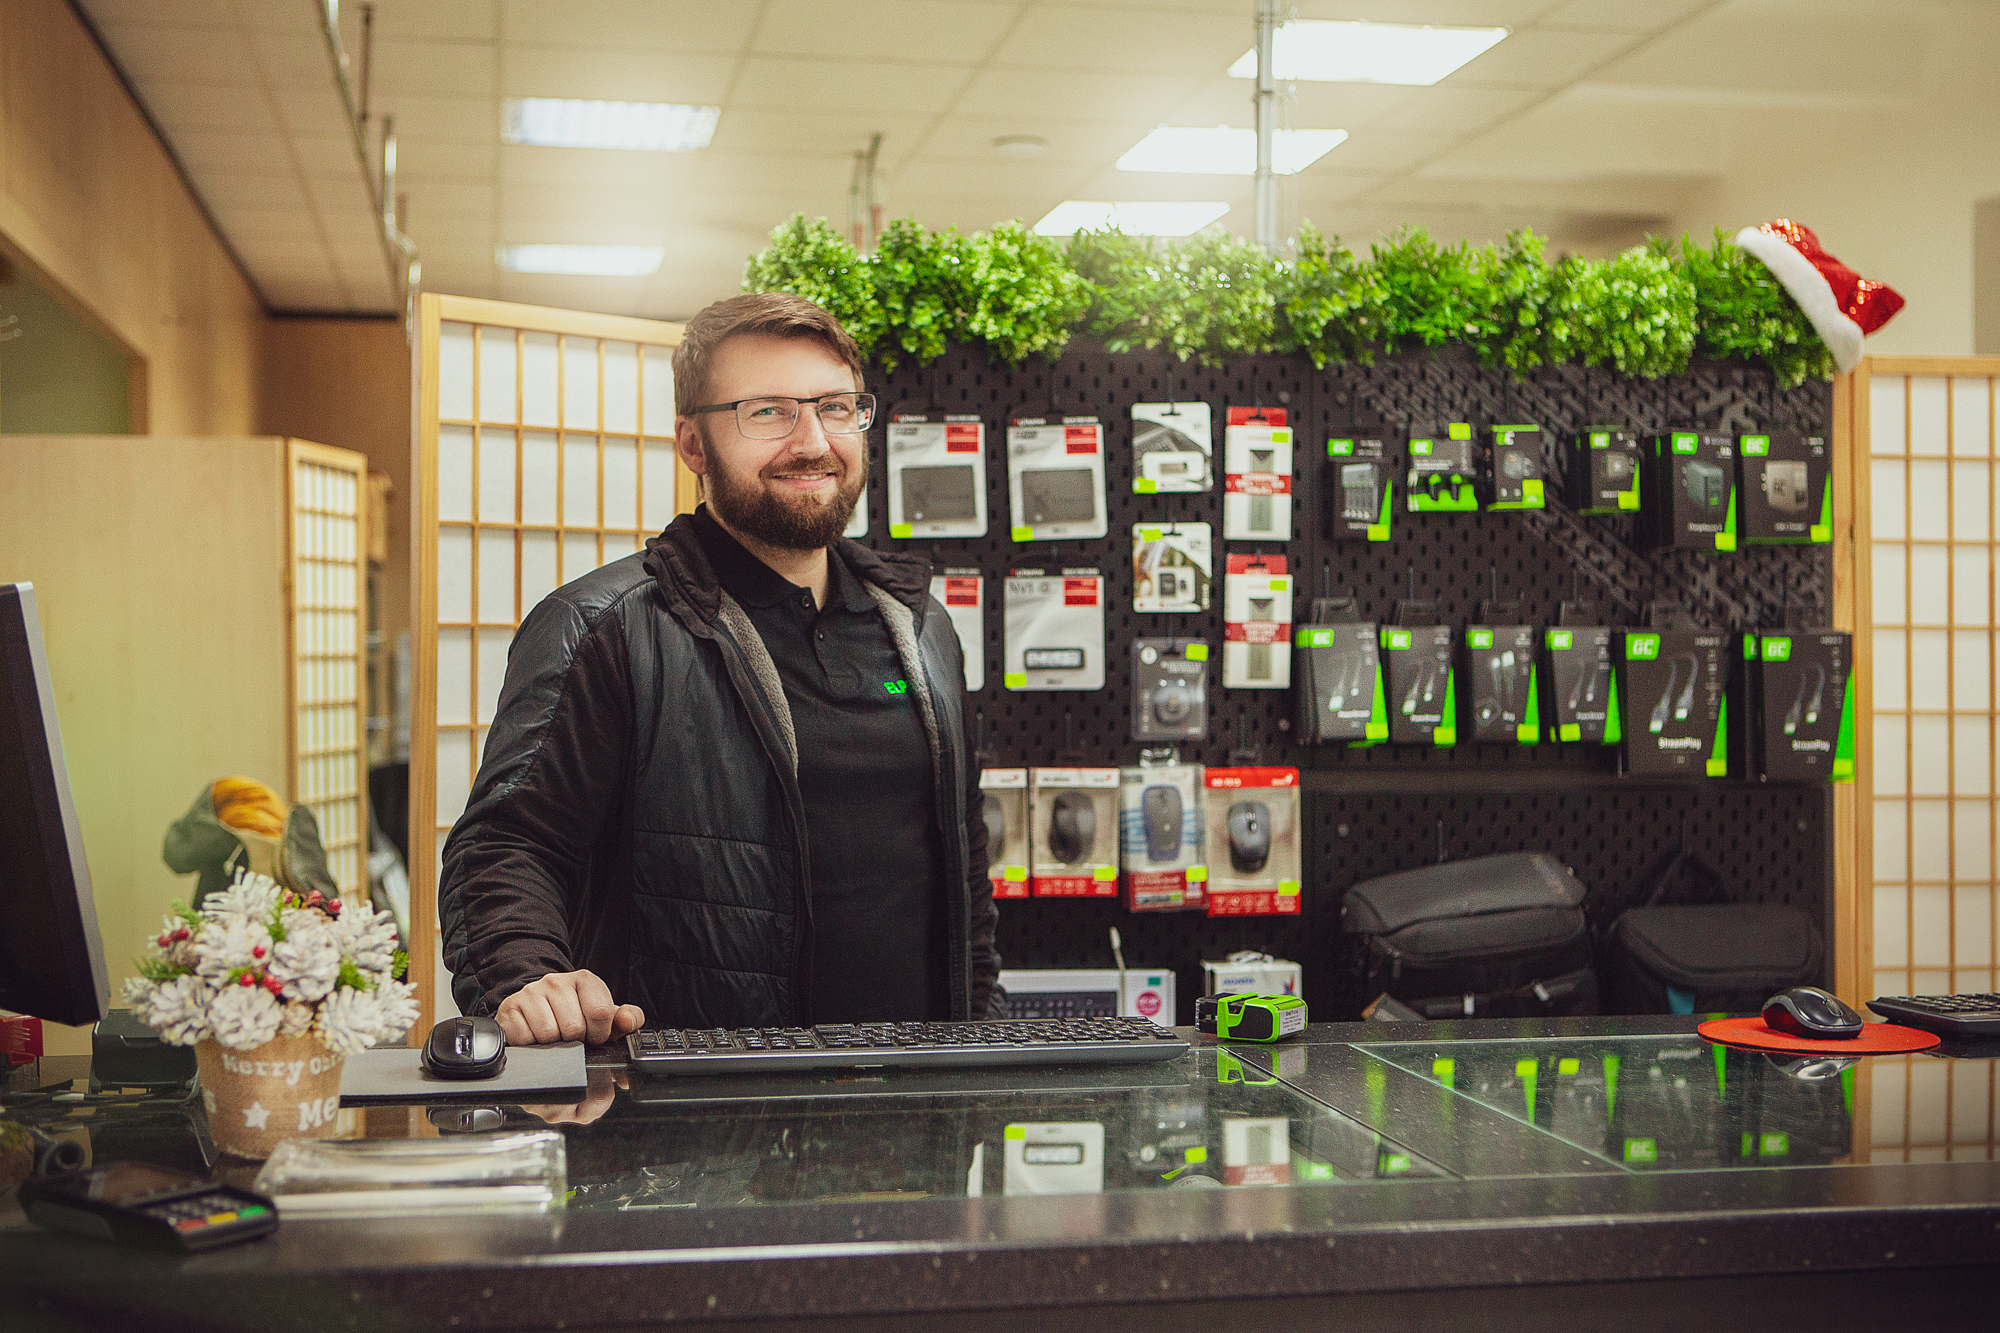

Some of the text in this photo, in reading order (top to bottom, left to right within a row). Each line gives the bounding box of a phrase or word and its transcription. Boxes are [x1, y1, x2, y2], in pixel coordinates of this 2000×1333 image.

[1745, 437, 1765, 454] GC
[1632, 639, 1655, 656] GC
[1767, 642, 1787, 658] GC
